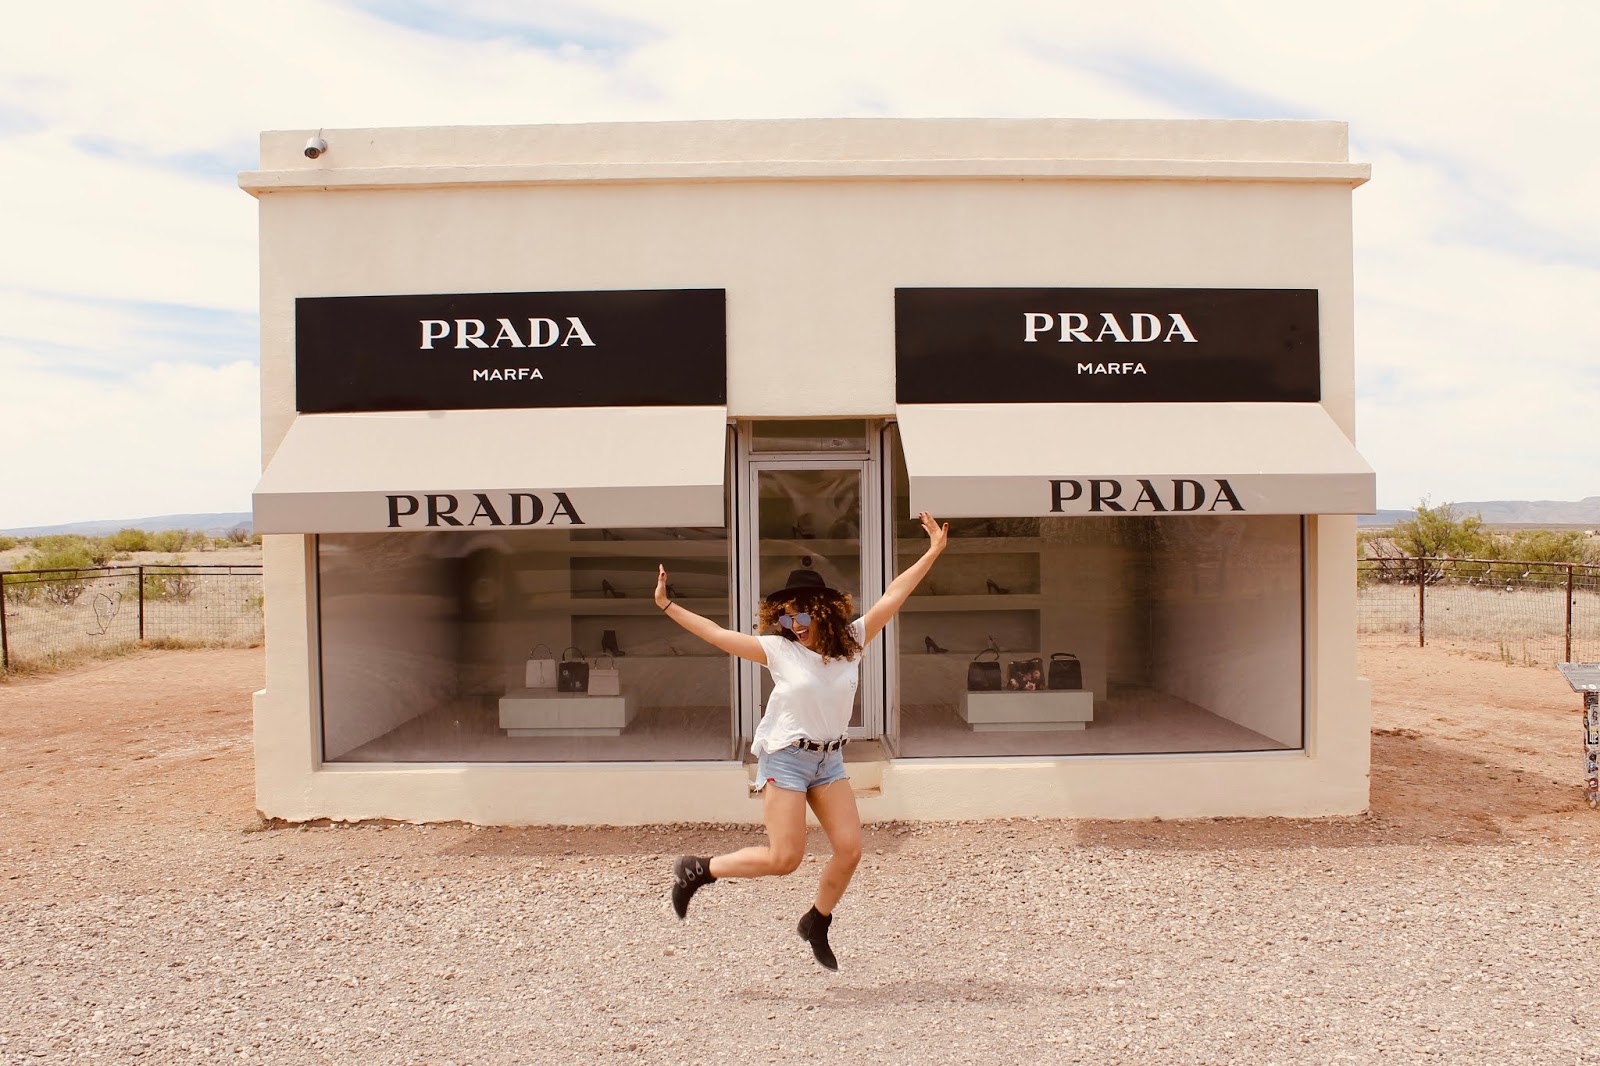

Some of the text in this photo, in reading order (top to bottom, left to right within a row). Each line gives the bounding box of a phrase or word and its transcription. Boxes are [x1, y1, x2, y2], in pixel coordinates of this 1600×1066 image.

[419, 316, 597, 350] PRADA
[1023, 312, 1199, 343] PRADA
[472, 368, 544, 382] MARFA
[1077, 362, 1147, 375] MARFA
[386, 492, 585, 528] PRADA
[1049, 479, 1246, 513] PRADA
